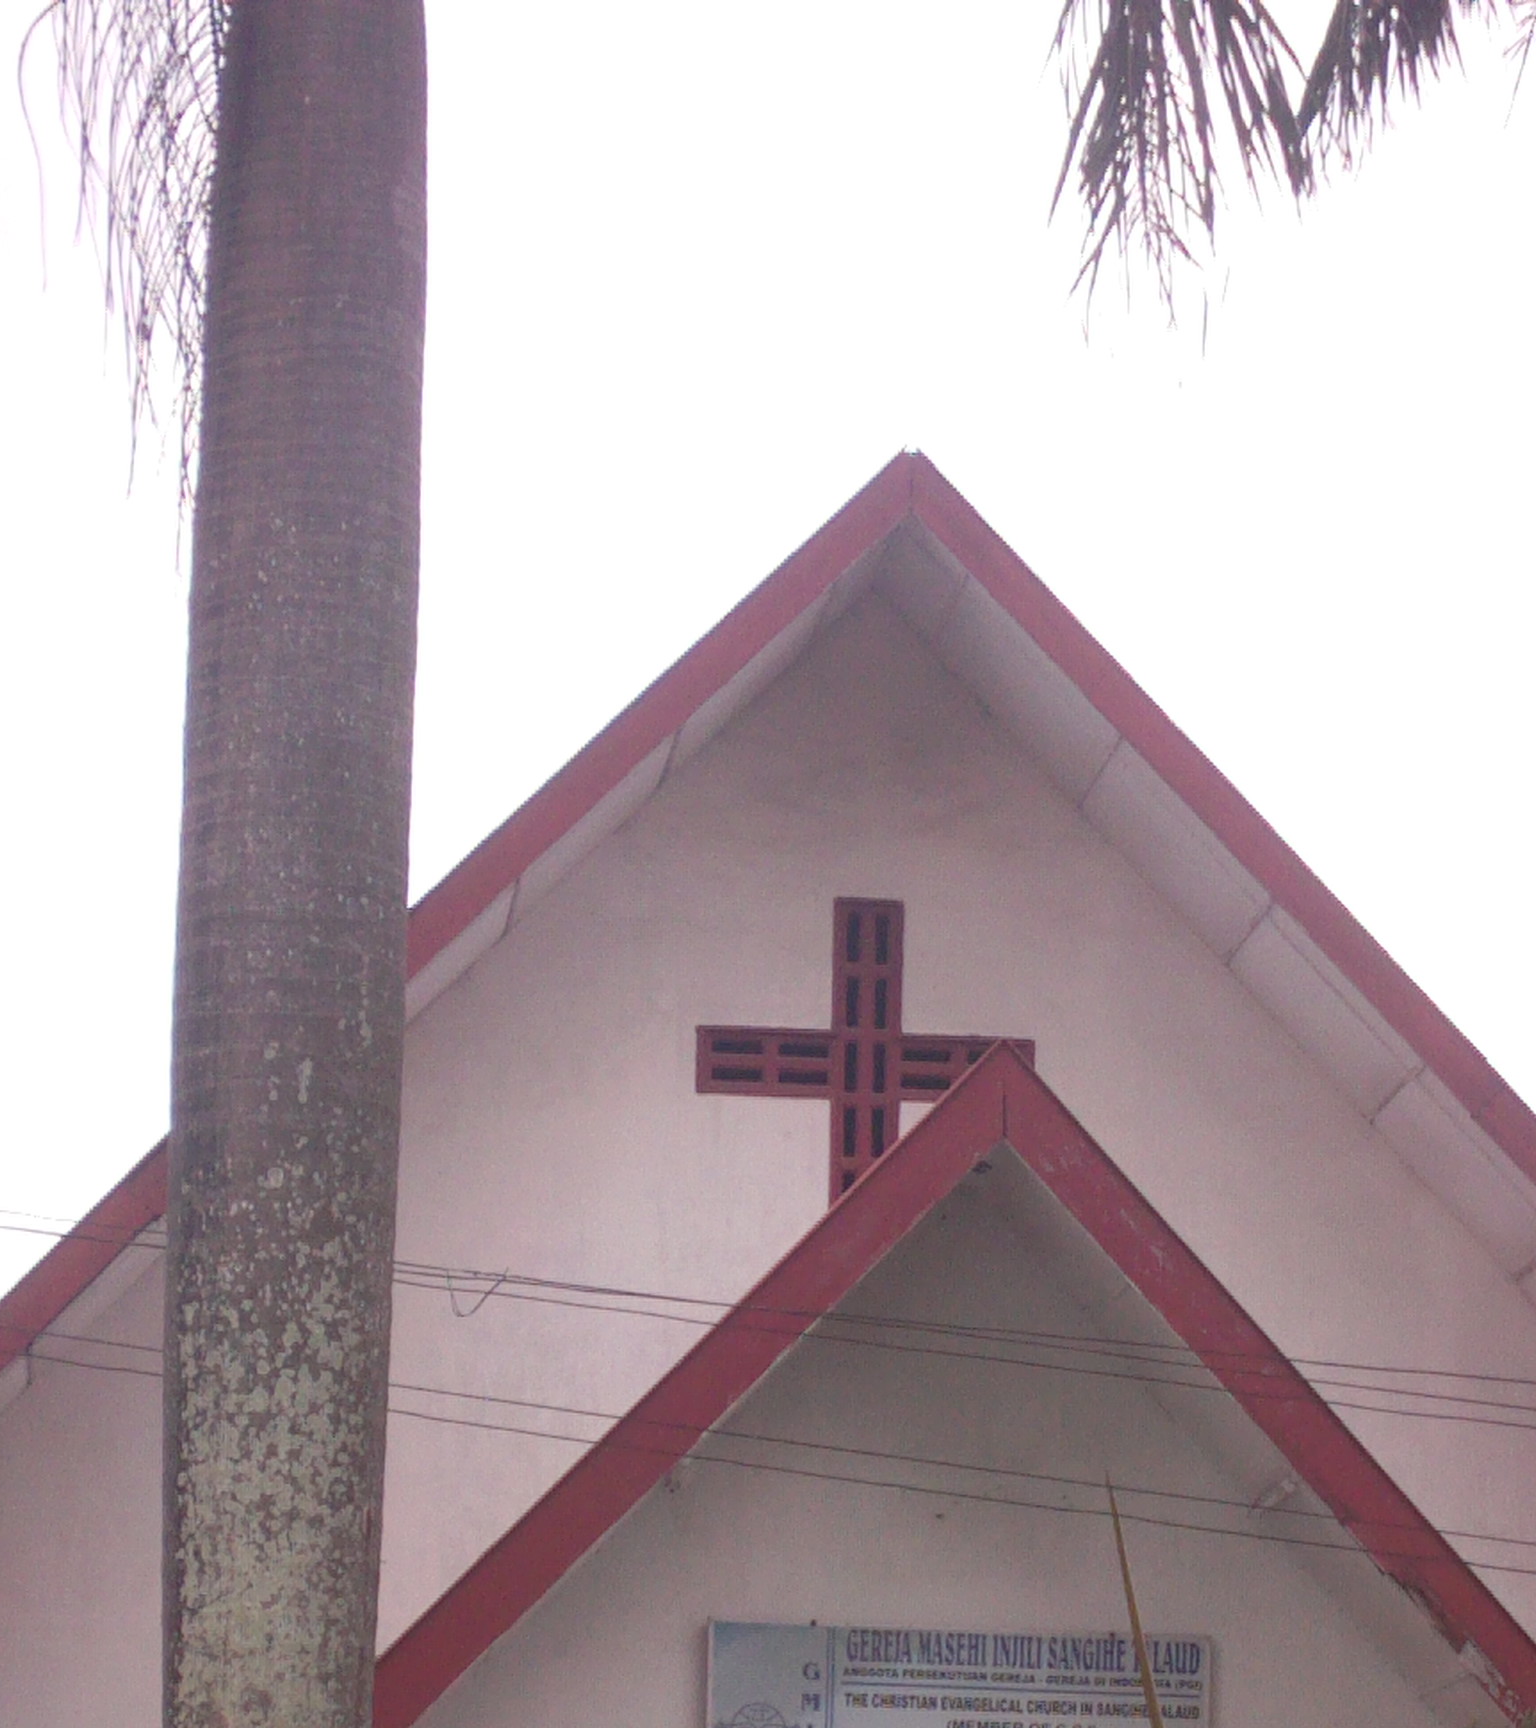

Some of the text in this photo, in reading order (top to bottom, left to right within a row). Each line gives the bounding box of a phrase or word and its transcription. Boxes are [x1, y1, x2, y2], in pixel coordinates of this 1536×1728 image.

[846, 1629, 1201, 1675] GEREJA MASEHI INJILI SANGIHE LAUD
[842, 1667, 899, 1679] ANGGOTA
[844, 1693, 869, 1708] THE
[871, 1693, 939, 1711] CHRISTIAN
[941, 1696, 1024, 1713] EVANGELICAL
[1026, 1700, 1077, 1716] CHURCH
[1080, 1702, 1093, 1717] IN
[1154, 1705, 1200, 1720] ALAUD
